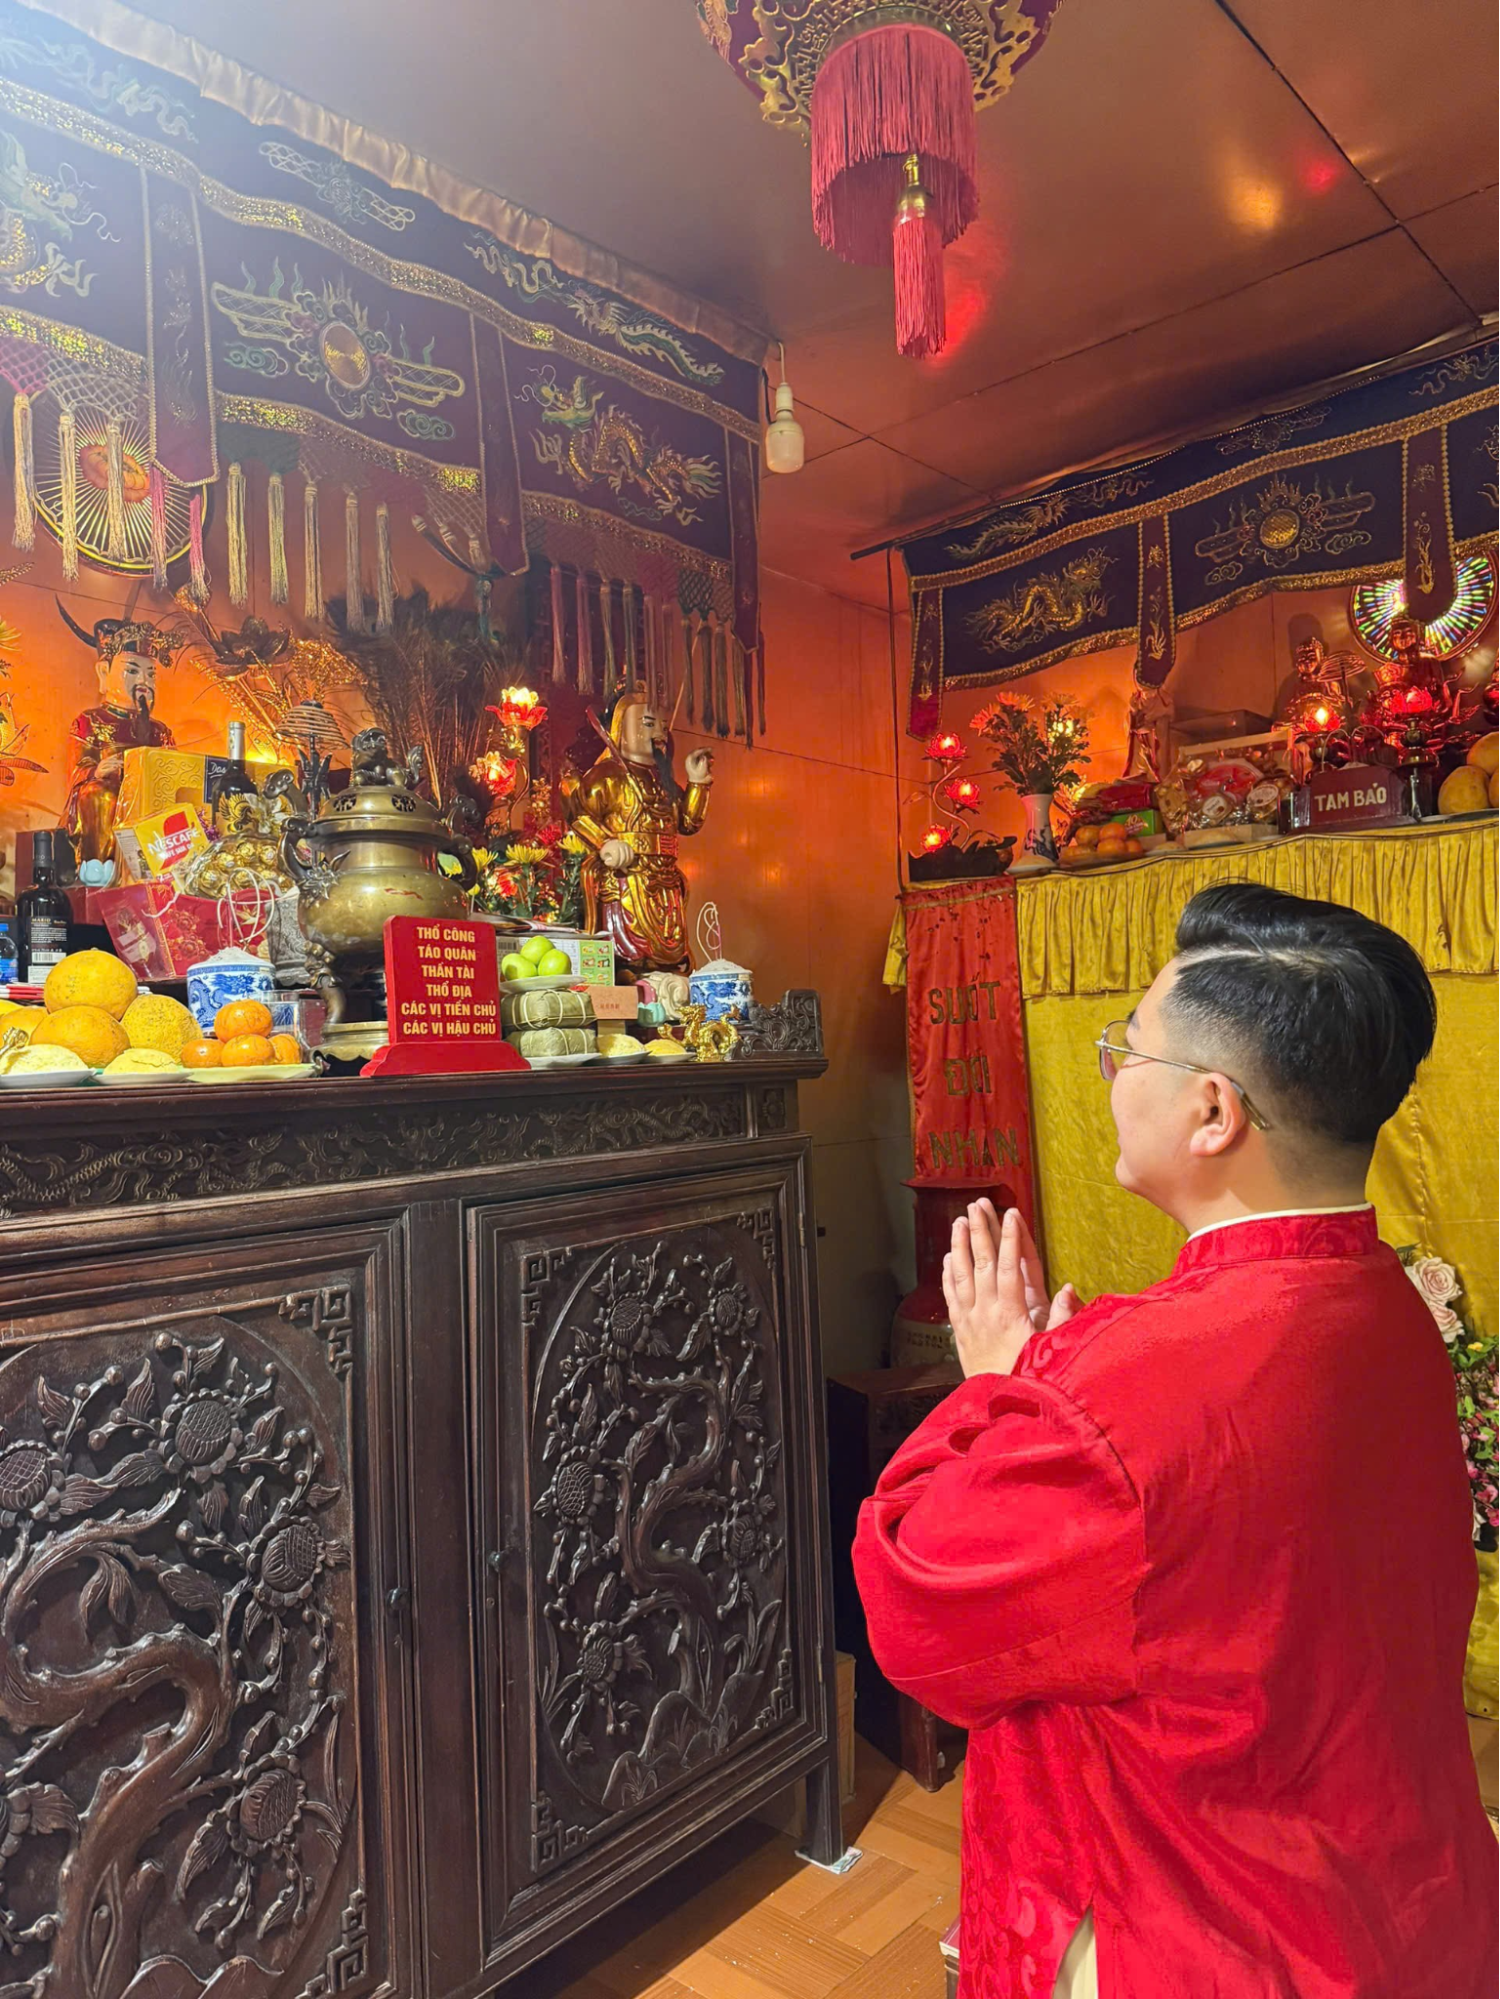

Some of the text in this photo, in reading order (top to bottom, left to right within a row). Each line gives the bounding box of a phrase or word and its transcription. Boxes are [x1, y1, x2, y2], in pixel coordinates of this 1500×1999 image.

[1314, 782, 1387, 812] TAM BẢO
[417, 923, 475, 942] THỔ CÔNG
[418, 944, 476, 961] TÁO QUÂN
[456, 965, 474, 979] TÀI
[426, 980, 472, 1000] THỔ ĐỊA
[401, 1001, 426, 1015] CÁC
[429, 1003, 442, 1018] VỊ
[473, 1001, 496, 1016] CHỦ
[403, 1019, 496, 1037] CÁC VỊ HẬU CHỦ
